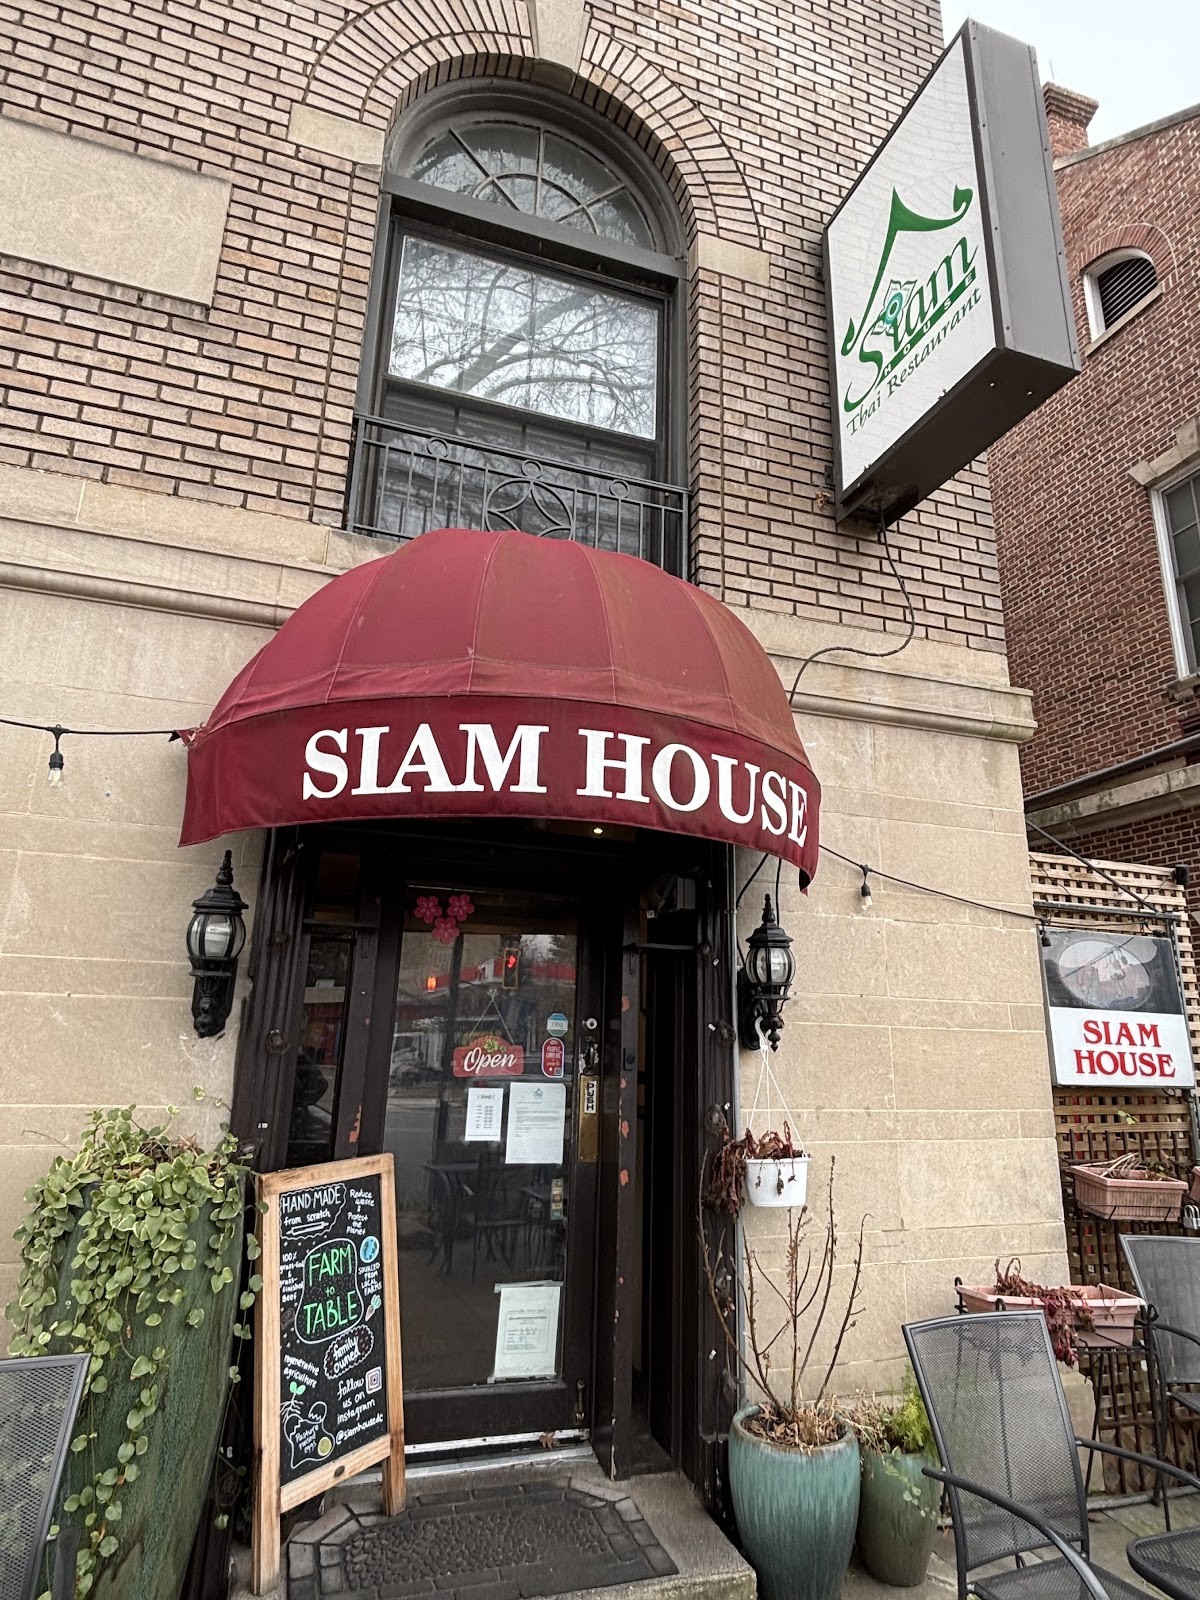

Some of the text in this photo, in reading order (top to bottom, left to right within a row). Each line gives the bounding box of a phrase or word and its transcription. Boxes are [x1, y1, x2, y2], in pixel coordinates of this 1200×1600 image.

[844, 236, 979, 413] Siam
[882, 270, 975, 378] HOUSE
[846, 287, 982, 436] Thai Restaurant
[302, 723, 808, 848] SIAM HOUSE
[1083, 1020, 1162, 1048] SIAM
[463, 1047, 517, 1074] Open
[1073, 1049, 1177, 1078] HOUSE
[585, 1083, 595, 1111] PUSH
[350, 1189, 373, 1199] Reduce
[284, 1208, 331, 1226] from scratch
[282, 1251, 297, 1263] 100%
[308, 1244, 352, 1287] FARM
[325, 1286, 335, 1295] to
[303, 1290, 358, 1334] TABLE
[333, 1336, 360, 1360] family
[333, 1346, 361, 1373] owned
[337, 1378, 364, 1401] follow
[342, 1391, 365, 1409] us on
[336, 1399, 375, 1425] instagram
